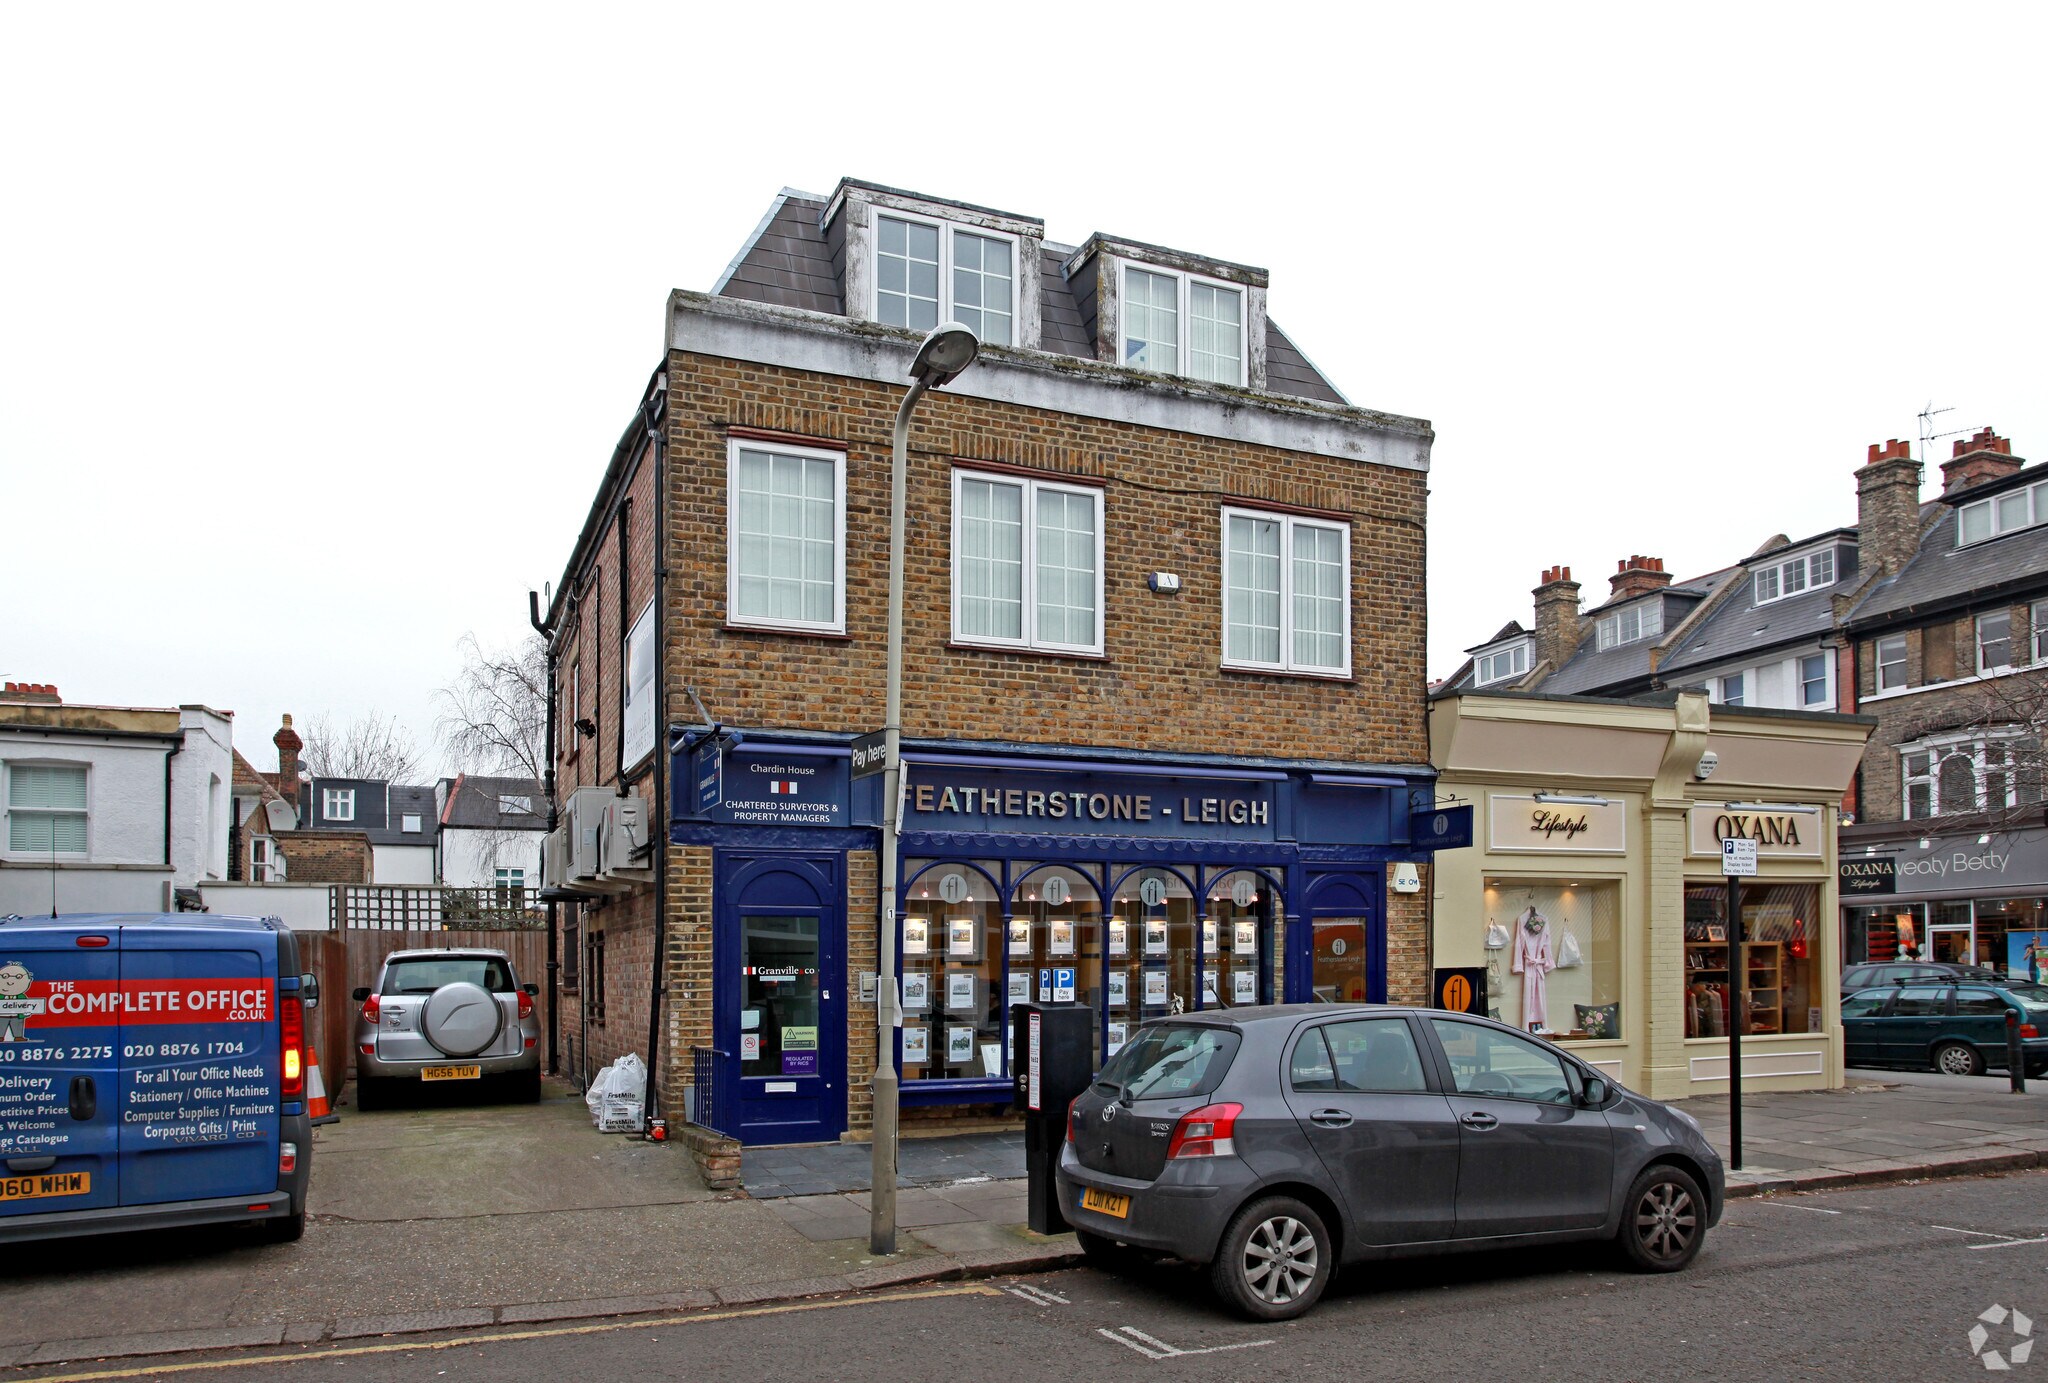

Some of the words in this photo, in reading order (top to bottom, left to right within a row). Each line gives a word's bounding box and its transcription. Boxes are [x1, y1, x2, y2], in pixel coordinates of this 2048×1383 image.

[852, 748, 866, 768] Pay
[867, 744, 886, 763] here
[750, 763, 785, 774] Chardin
[788, 765, 815, 775] House
[725, 800, 777, 810] CHARTERED
[779, 802, 830, 812] SURVEYORS
[831, 804, 839, 812] &
[1183, 797, 1268, 824] LEIGH
[734, 812, 779, 821] PROPERTY
[781, 813, 830, 823] MANAGERS
[1531, 810, 1588, 840] Lifestyle
[1713, 815, 1801, 847] OXANA
[1726, 842, 1733, 853] P
[1953, 850, 2010, 873] Betty
[1840, 862, 1894, 877] OXANA
[1851, 879, 1881, 889] Lifestyle
[1058, 970, 1071, 988] P
[48, 981, 75, 992] THE
[1058, 989, 1070, 997] Pay
[2, 1001, 37, 1011] delivery
[48, 991, 181, 1014] COMPLETE
[187, 989, 267, 1010] OFFICE
[226, 1009, 266, 1020] .CO.UK
[21, 1048, 65, 1061] 8876
[71, 1046, 113, 1059] 2275
[123, 1044, 155, 1058] 020
[160, 1043, 200, 1056] 8876
[207, 1041, 244, 1054] 1704
[135, 1070, 154, 1084] For
[156, 1069, 169, 1083] all
[172, 1068, 198, 1082] Your
[200, 1067, 230, 1080] Office
[233, 1065, 264, 1078] Needs
[426, 1068, 454, 1078] HG56
[456, 1067, 475, 1077] TUV
[24, 1092, 57, 1101] Order
[130, 1090, 184, 1103] Stationery
[193, 1087, 223, 1099] Office
[225, 1085, 270, 1098] Machines
[0, 1106, 35, 1117] etitive
[37, 1105, 69, 1116] Prices
[124, 1109, 176, 1124] Computer
[178, 1105, 220, 1121] Supplies
[229, 1103, 275, 1116] Furniture
[7, 1121, 56, 1130] Welcome
[144, 1125, 197, 1140] Corporate
[199, 1120, 223, 1134] Gifts
[232, 1119, 257, 1132] Print
[16, 1134, 69, 1146] Catalogue
[174, 1134, 229, 1143] VIVARO
[0, 1146, 41, 1154] HALL
[0, 1178, 34, 1197] 60
[40, 1174, 82, 1194] WHW
